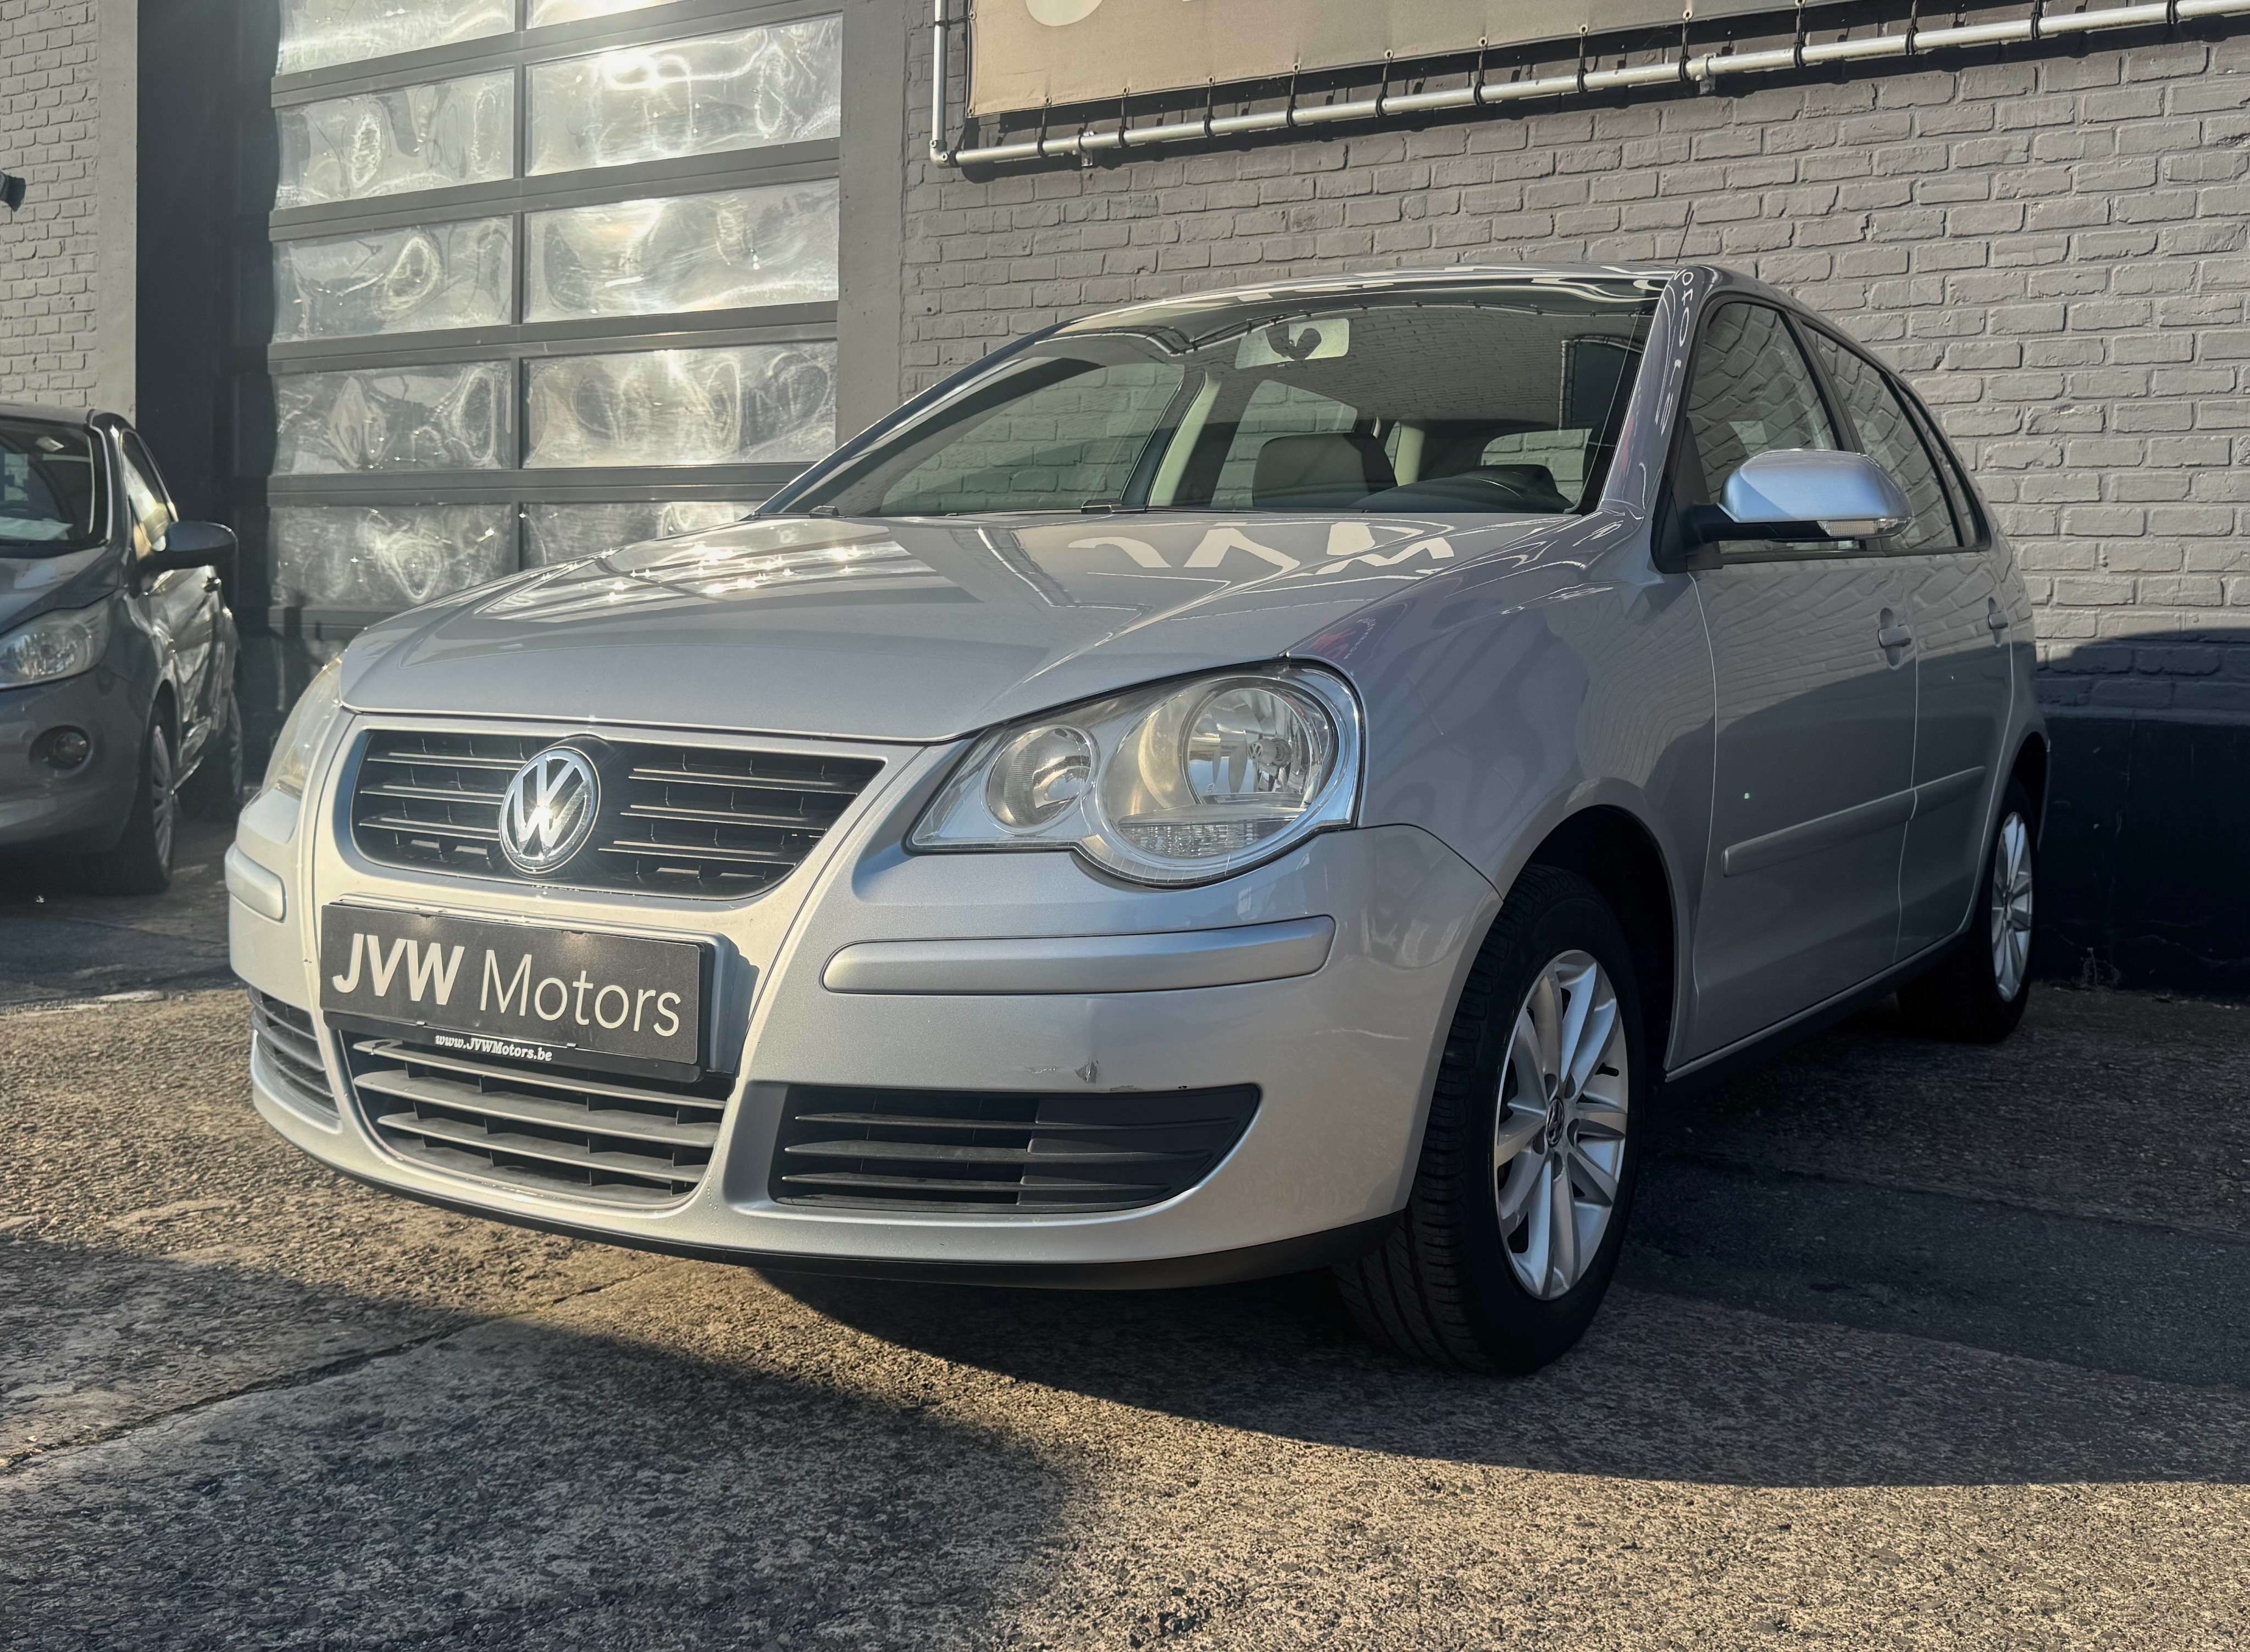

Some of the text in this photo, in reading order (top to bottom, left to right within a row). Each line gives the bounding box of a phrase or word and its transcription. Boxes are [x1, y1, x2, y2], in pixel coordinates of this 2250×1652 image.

[502, 749, 596, 866] VW
[332, 933, 681, 1038] JVW Motors
[435, 1034, 552, 1062] www.JVWMotors.be
